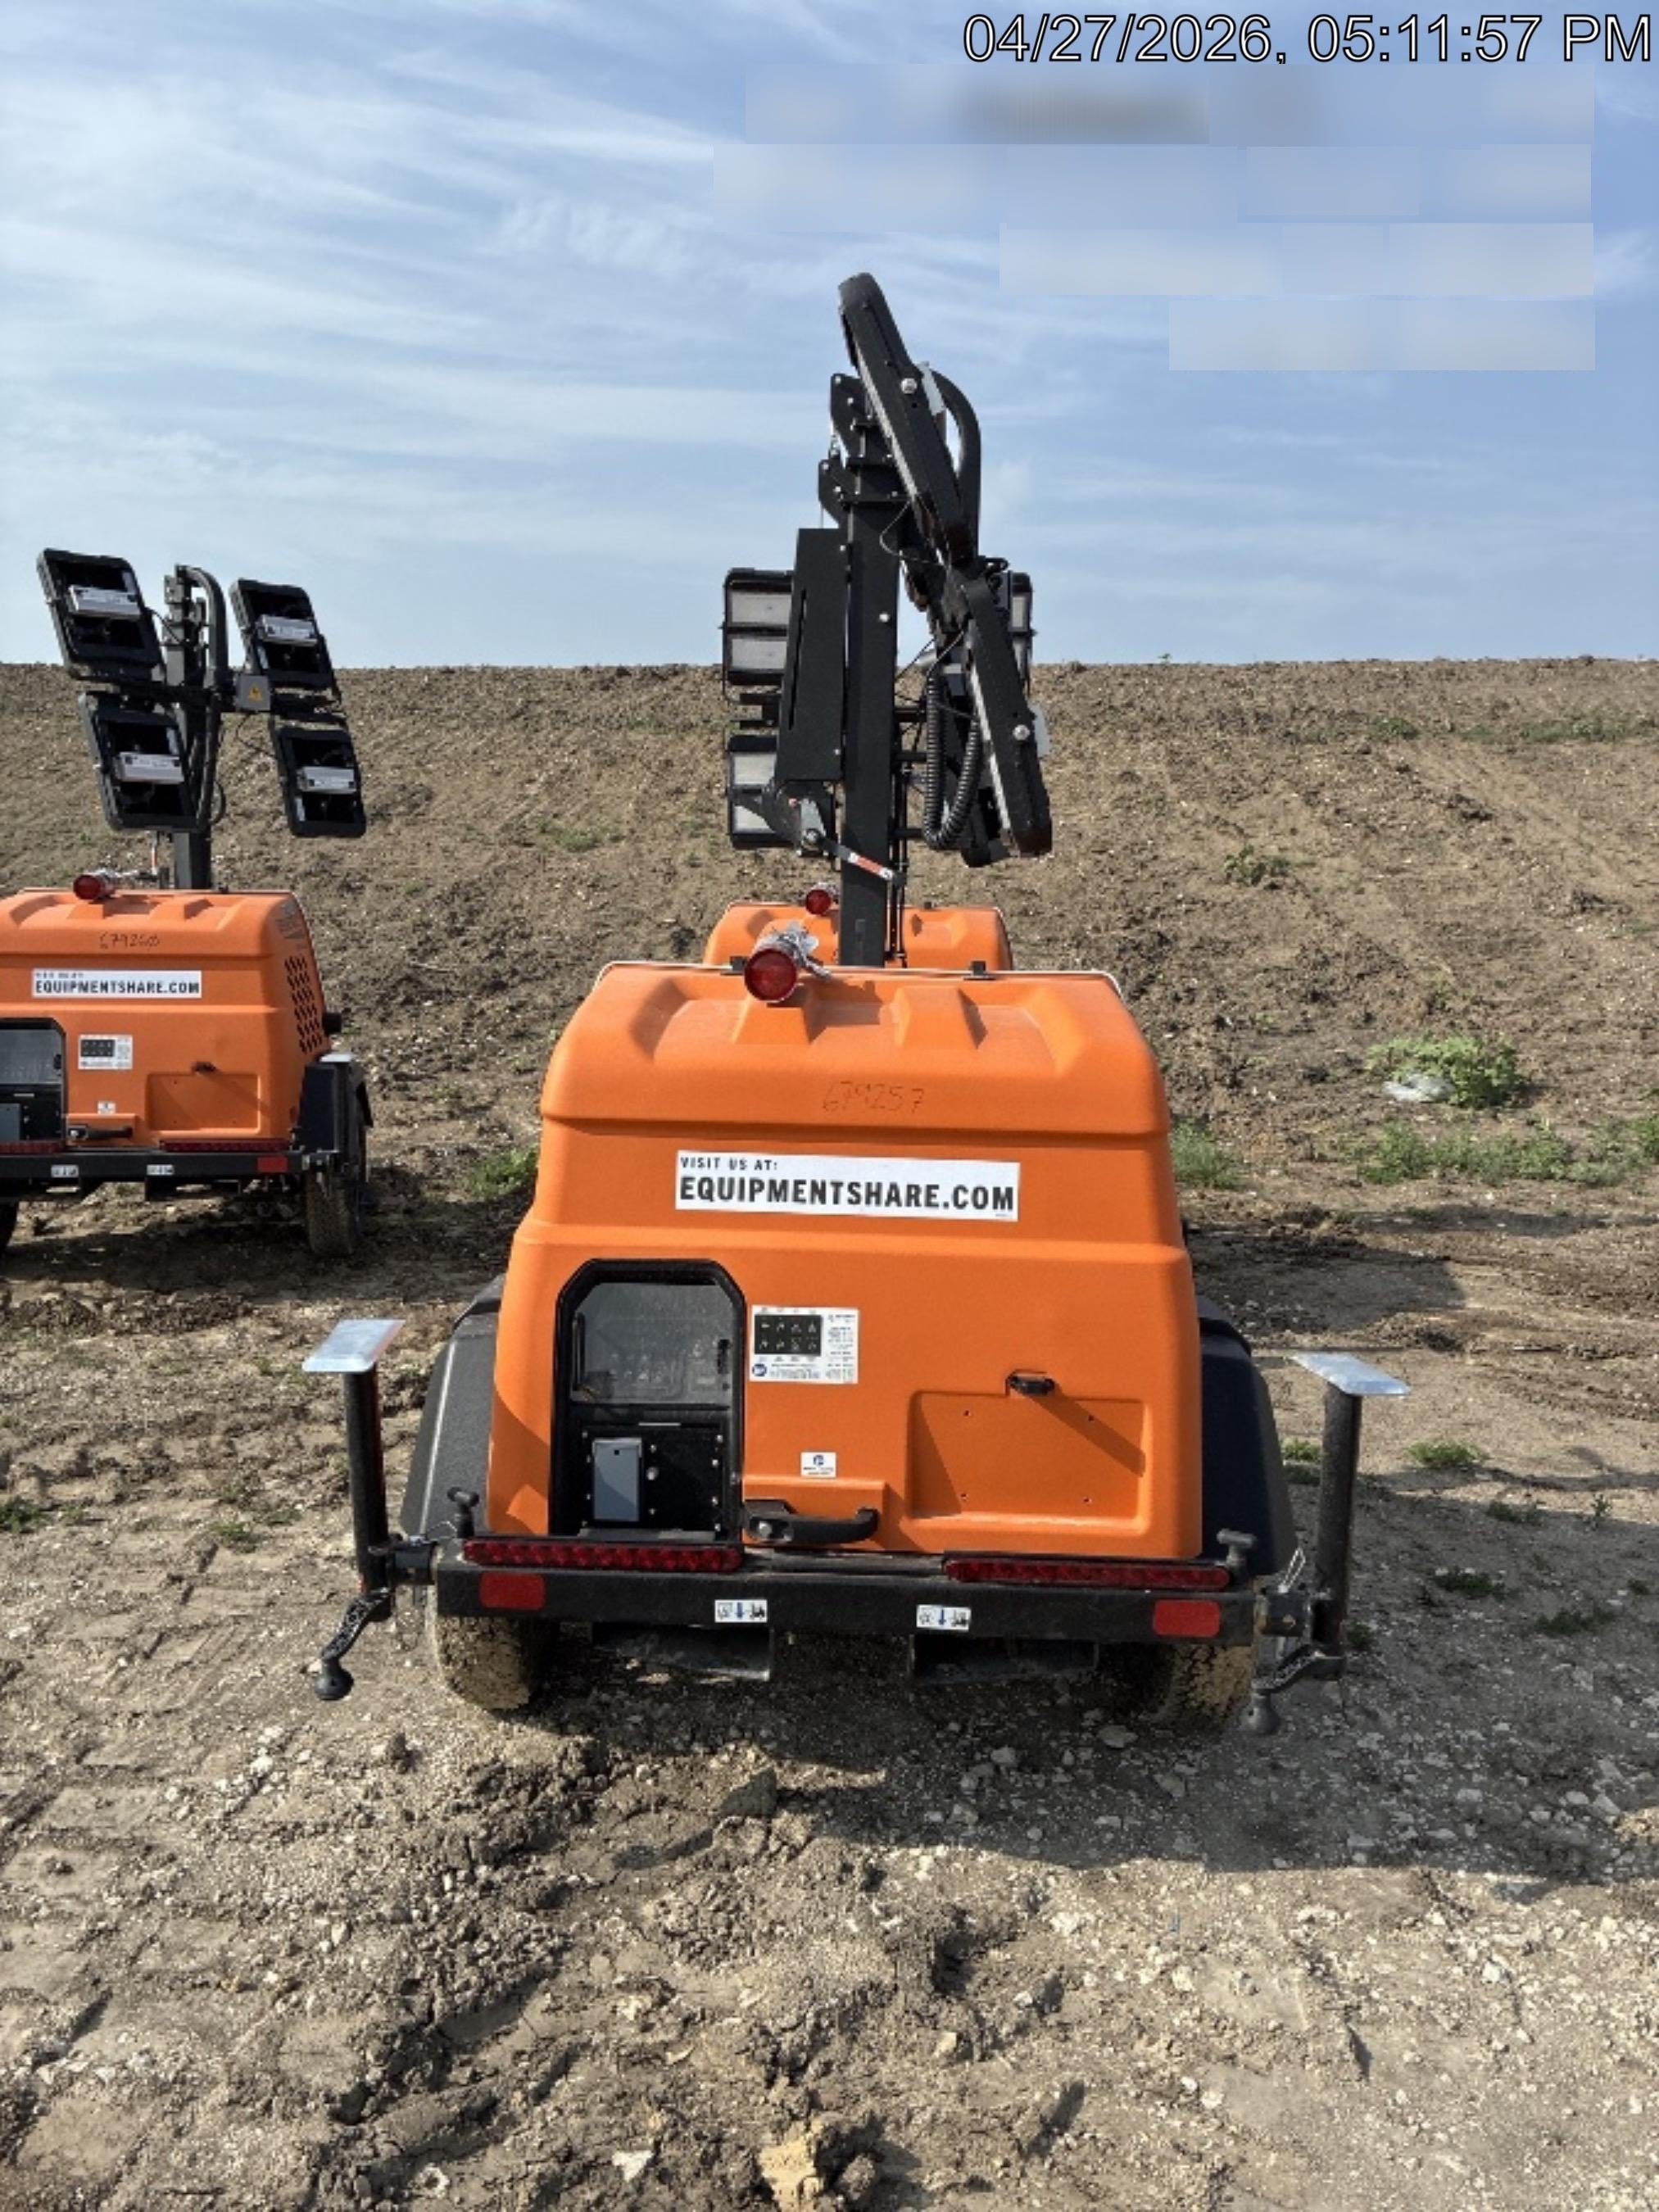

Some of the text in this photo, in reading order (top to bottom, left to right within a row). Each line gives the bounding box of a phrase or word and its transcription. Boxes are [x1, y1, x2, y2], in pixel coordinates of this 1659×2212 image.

[36, 980, 200, 994] EQUIPMENTSHARE.COM
[680, 1156, 777, 1172] VISIT US AT:
[680, 1176, 1013, 1212] EQUIPMENTSHARE.COM
